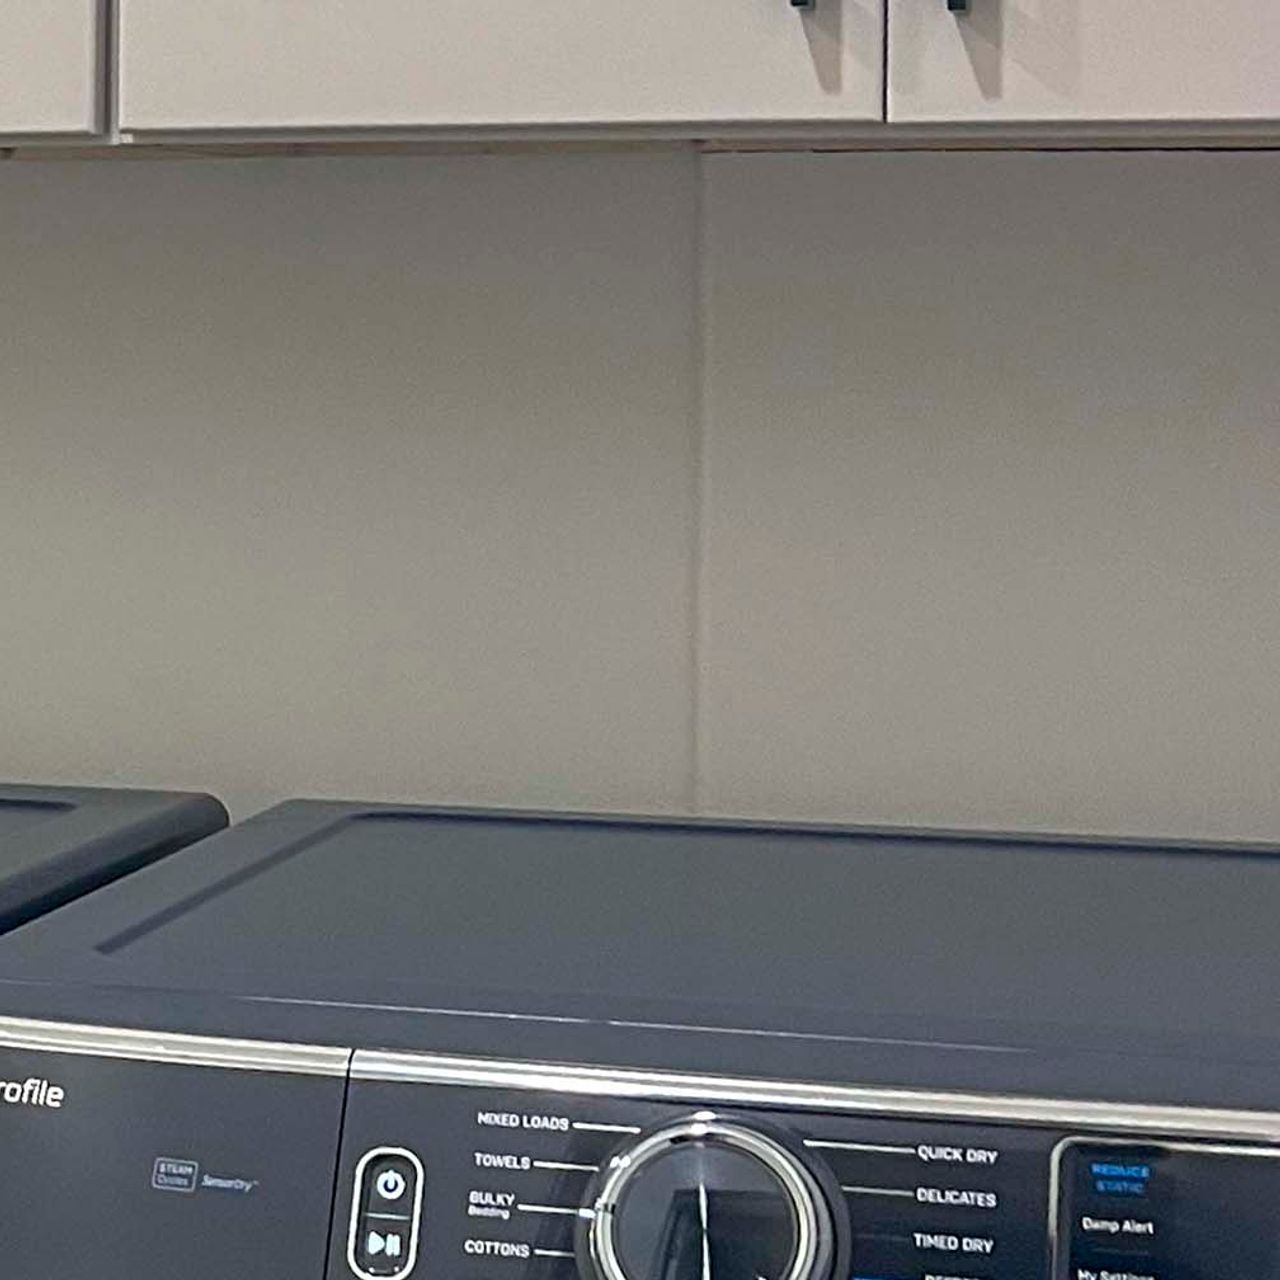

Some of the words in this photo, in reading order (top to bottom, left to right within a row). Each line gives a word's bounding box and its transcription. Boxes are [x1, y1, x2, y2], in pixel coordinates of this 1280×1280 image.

[477, 1112, 520, 1128] MIXED
[523, 1115, 569, 1131] LOADS
[474, 1152, 531, 1170] TOWELS
[917, 1145, 963, 1162] QUICK
[966, 1149, 998, 1164] DRY
[159, 1162, 193, 1174] STEAM
[1092, 1164, 1150, 1178] REDUCE
[1096, 1180, 1144, 1194] STATIC
[469, 1190, 515, 1206] BULKY
[916, 1187, 997, 1207] DELICATES
[1081, 1216, 1120, 1234] Damp
[1122, 1220, 1154, 1235] Alert
[464, 1240, 530, 1257] COTTONS
[913, 1232, 959, 1250] TIMED
[962, 1238, 994, 1254] DRY
